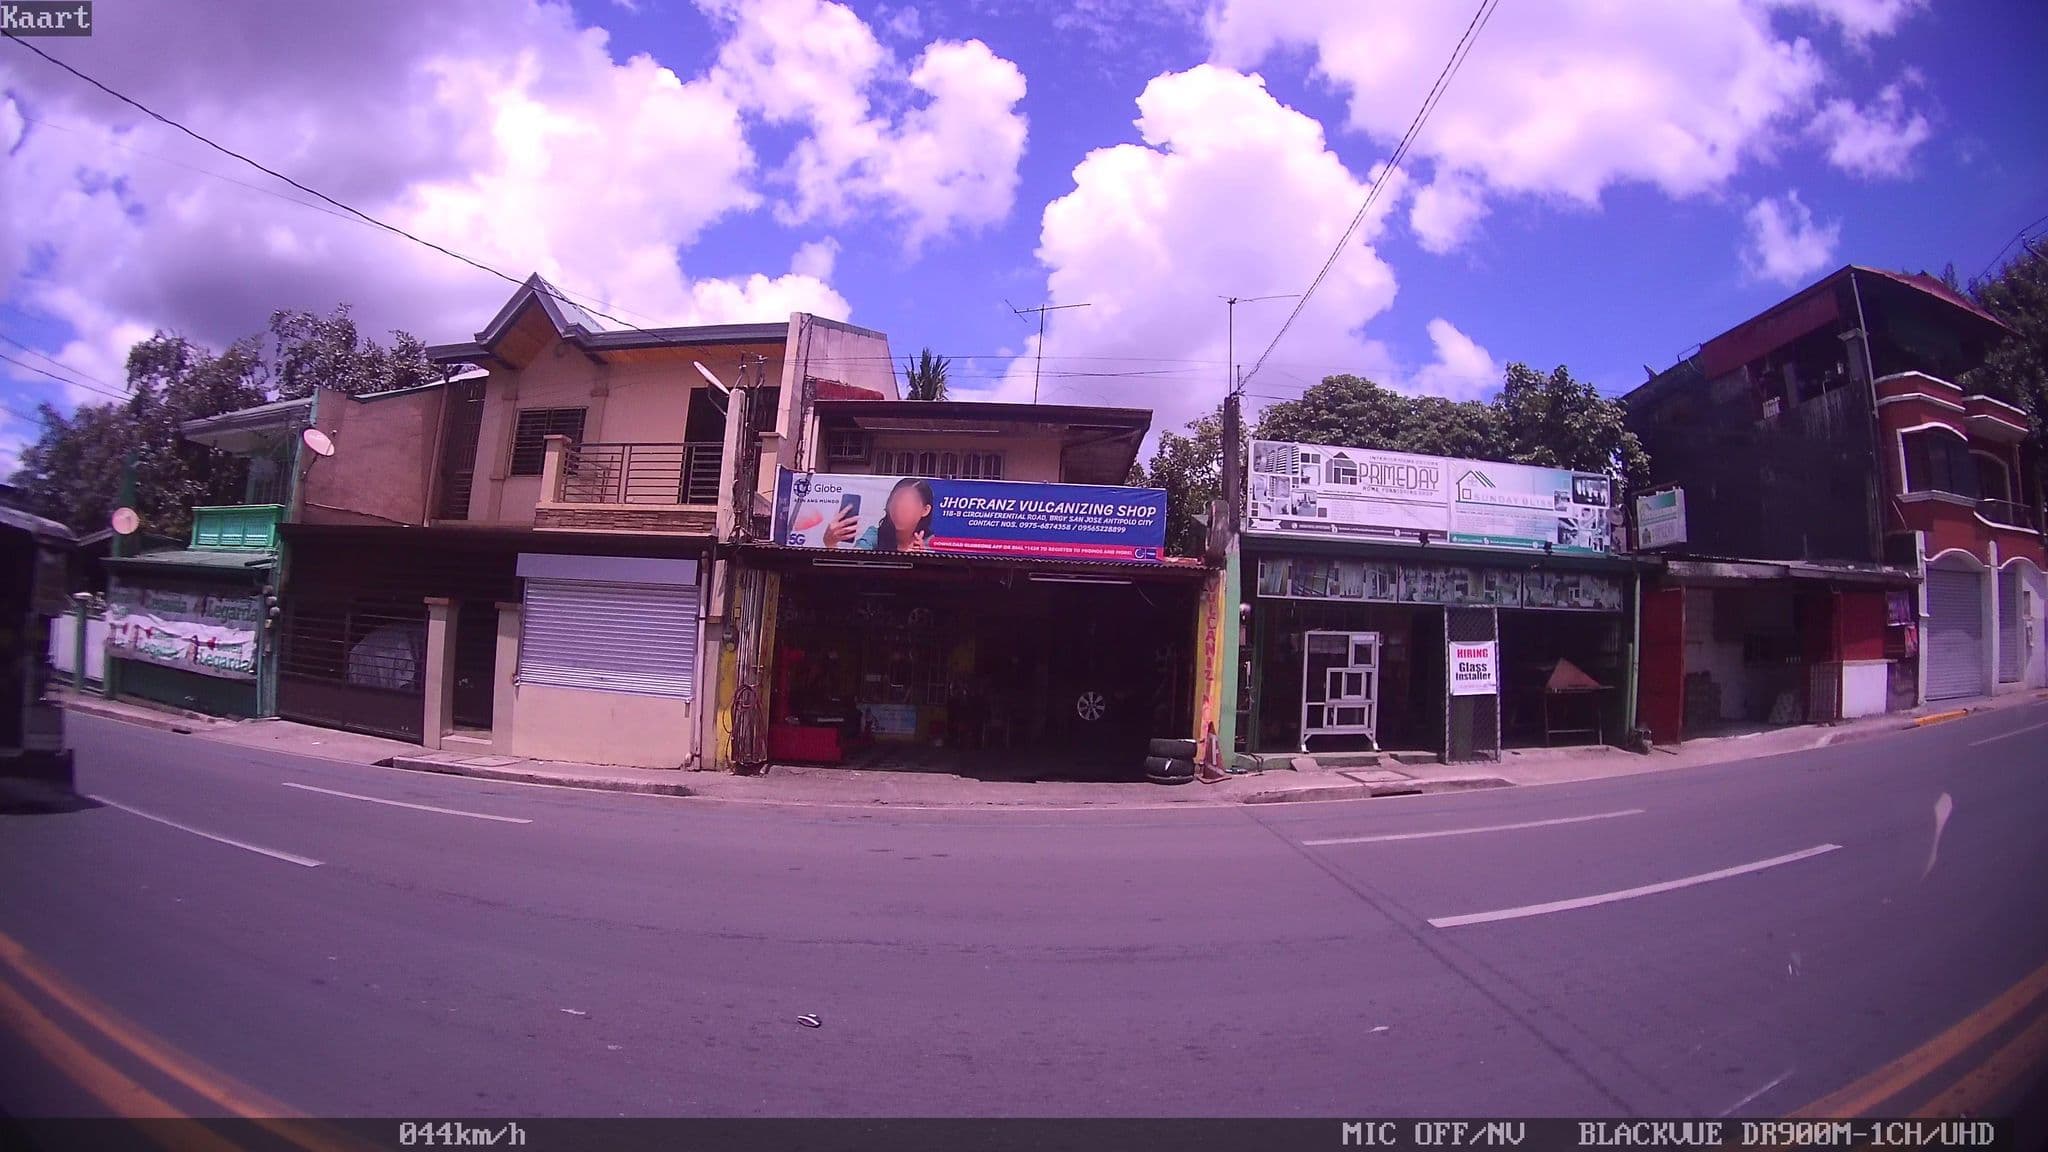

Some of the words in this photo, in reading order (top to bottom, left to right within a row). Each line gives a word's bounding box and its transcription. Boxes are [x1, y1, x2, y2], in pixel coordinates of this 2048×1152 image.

[1359, 462, 1439, 490] PRIMEDAY
[815, 484, 842, 493] Globe
[940, 497, 1017, 511] JHOFRANZ
[1019, 501, 1114, 516] VULCANIZING
[1116, 505, 1157, 518] SHOP
[962, 511, 1026, 520] CIRCUMFERENTIAL
[1103, 517, 1137, 526] ANTIPOLO
[1137, 519, 1154, 527] CITY
[968, 519, 1000, 527] CONTACT
[788, 533, 806, 545] 5G
[207, 600, 258, 623] Legarda
[1457, 648, 1489, 659] HIRING
[197, 651, 251, 673] Legarda
[1459, 661, 1488, 673] Glass
[1455, 671, 1491, 681] Installer
